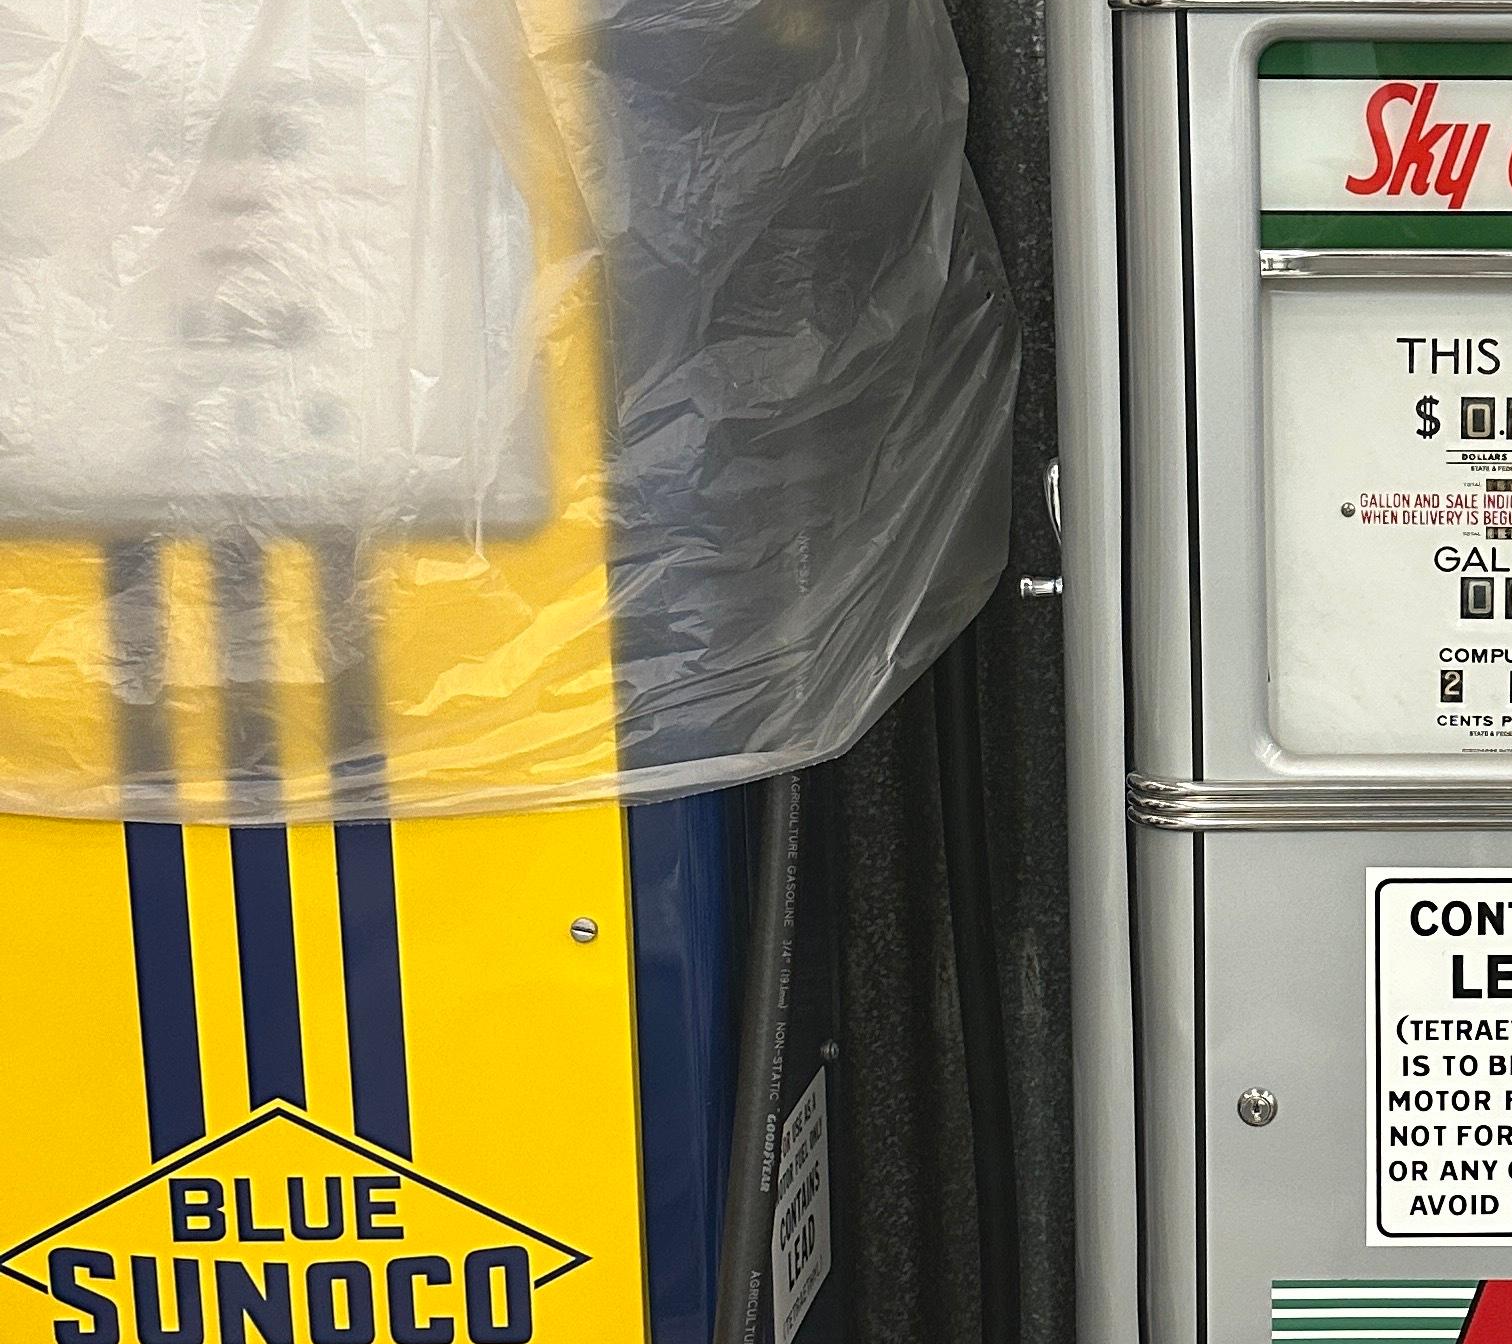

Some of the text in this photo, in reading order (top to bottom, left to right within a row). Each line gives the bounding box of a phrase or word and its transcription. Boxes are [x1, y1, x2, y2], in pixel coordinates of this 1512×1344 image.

[1345, 83, 1491, 209] Sky
[1397, 338, 1500, 374] THIS
[1360, 493, 1411, 508] GALLON
[1414, 494, 1440, 508] AND
[1446, 495, 1477, 508] SALE
[1361, 510, 1398, 525] WHEN
[1402, 510, 1462, 525] DELIVERY
[1466, 510, 1479, 525] IS
[1444, 671, 1461, 695] 2
[1437, 715, 1493, 726] CENTS
[787, 774, 801, 859] AGRICULTURE
[783, 865, 797, 928] GASOLINE
[769, 1021, 787, 1102] NON-STATIC
[1403, 1055, 1430, 1076] IS
[1443, 1055, 1478, 1076] TO
[1389, 1090, 1490, 1111] MOTOR
[1391, 1126, 1446, 1146] NOT
[1458, 1125, 1512, 1146] FOR
[759, 1113, 777, 1193] GOODYEAR
[1389, 1161, 1427, 1181] OR
[1440, 1160, 1497, 1180] ANY
[168, 1176, 404, 1242] BLUE
[779, 1158, 821, 1253] CONTAINS
[1410, 1195, 1499, 1215] AVOID
[787, 1211, 816, 1293] LEAD
